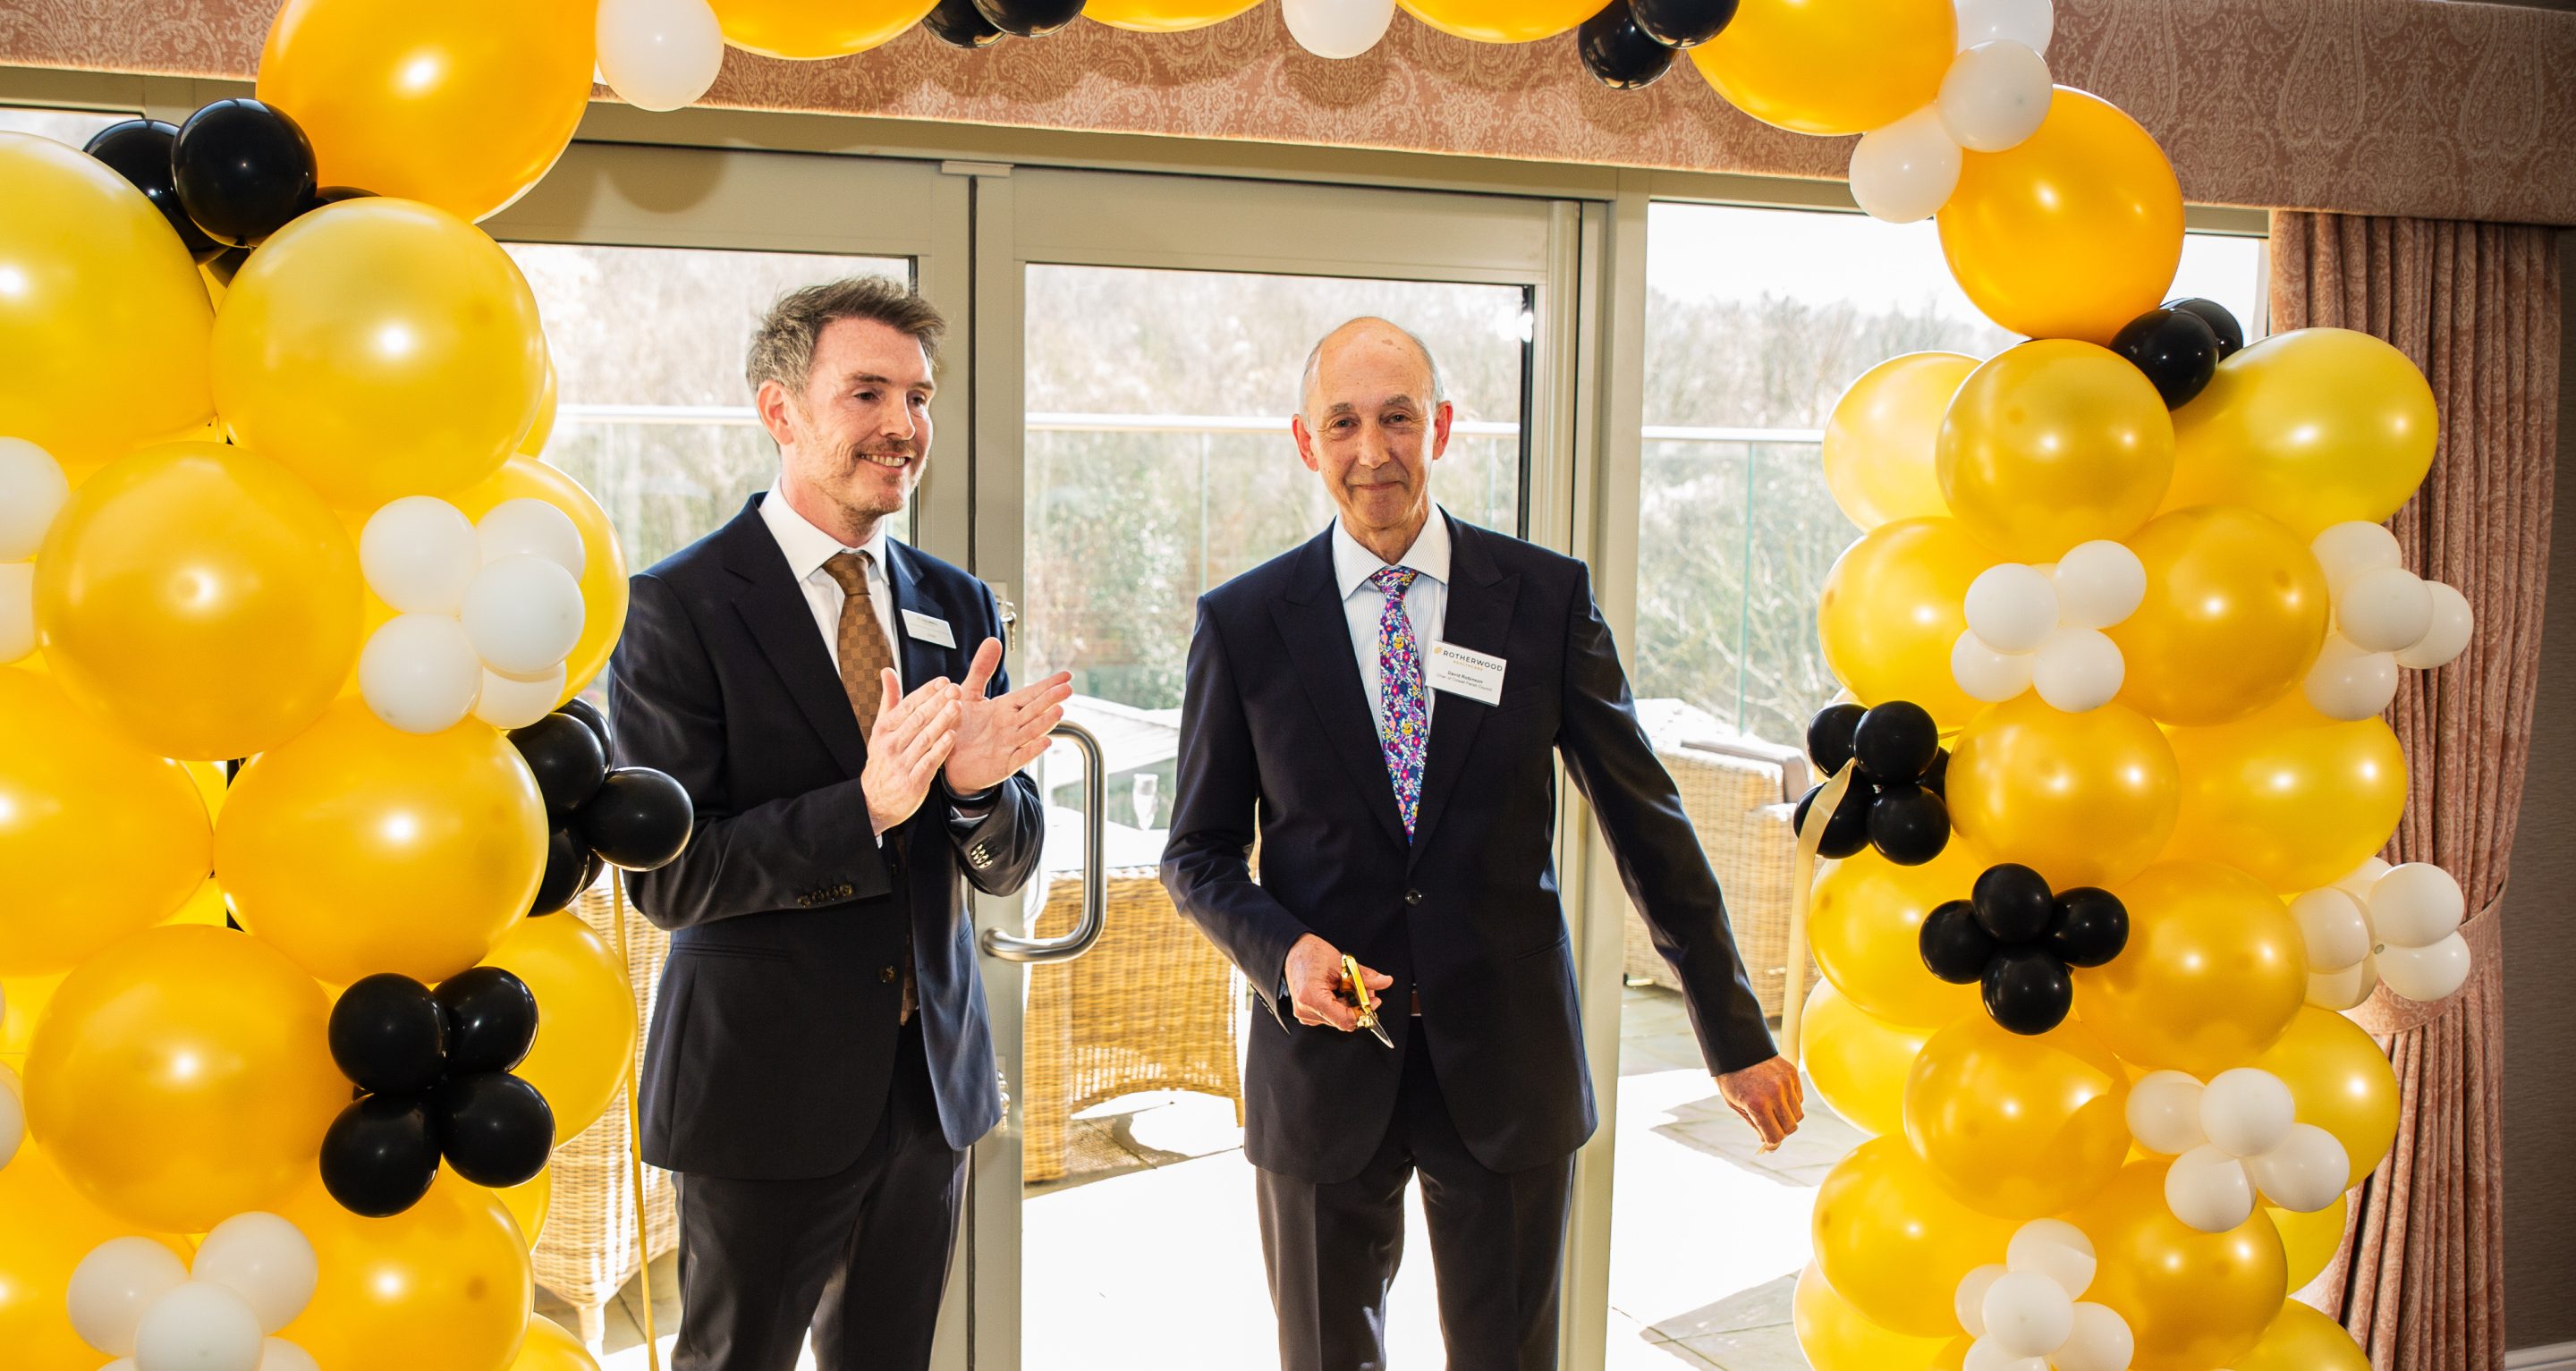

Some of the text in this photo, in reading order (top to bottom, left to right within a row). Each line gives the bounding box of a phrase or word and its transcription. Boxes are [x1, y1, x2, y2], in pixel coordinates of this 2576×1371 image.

[1443, 650, 1503, 672] ROTHERWOOD
[1447, 670, 1483, 684] David Robinson
